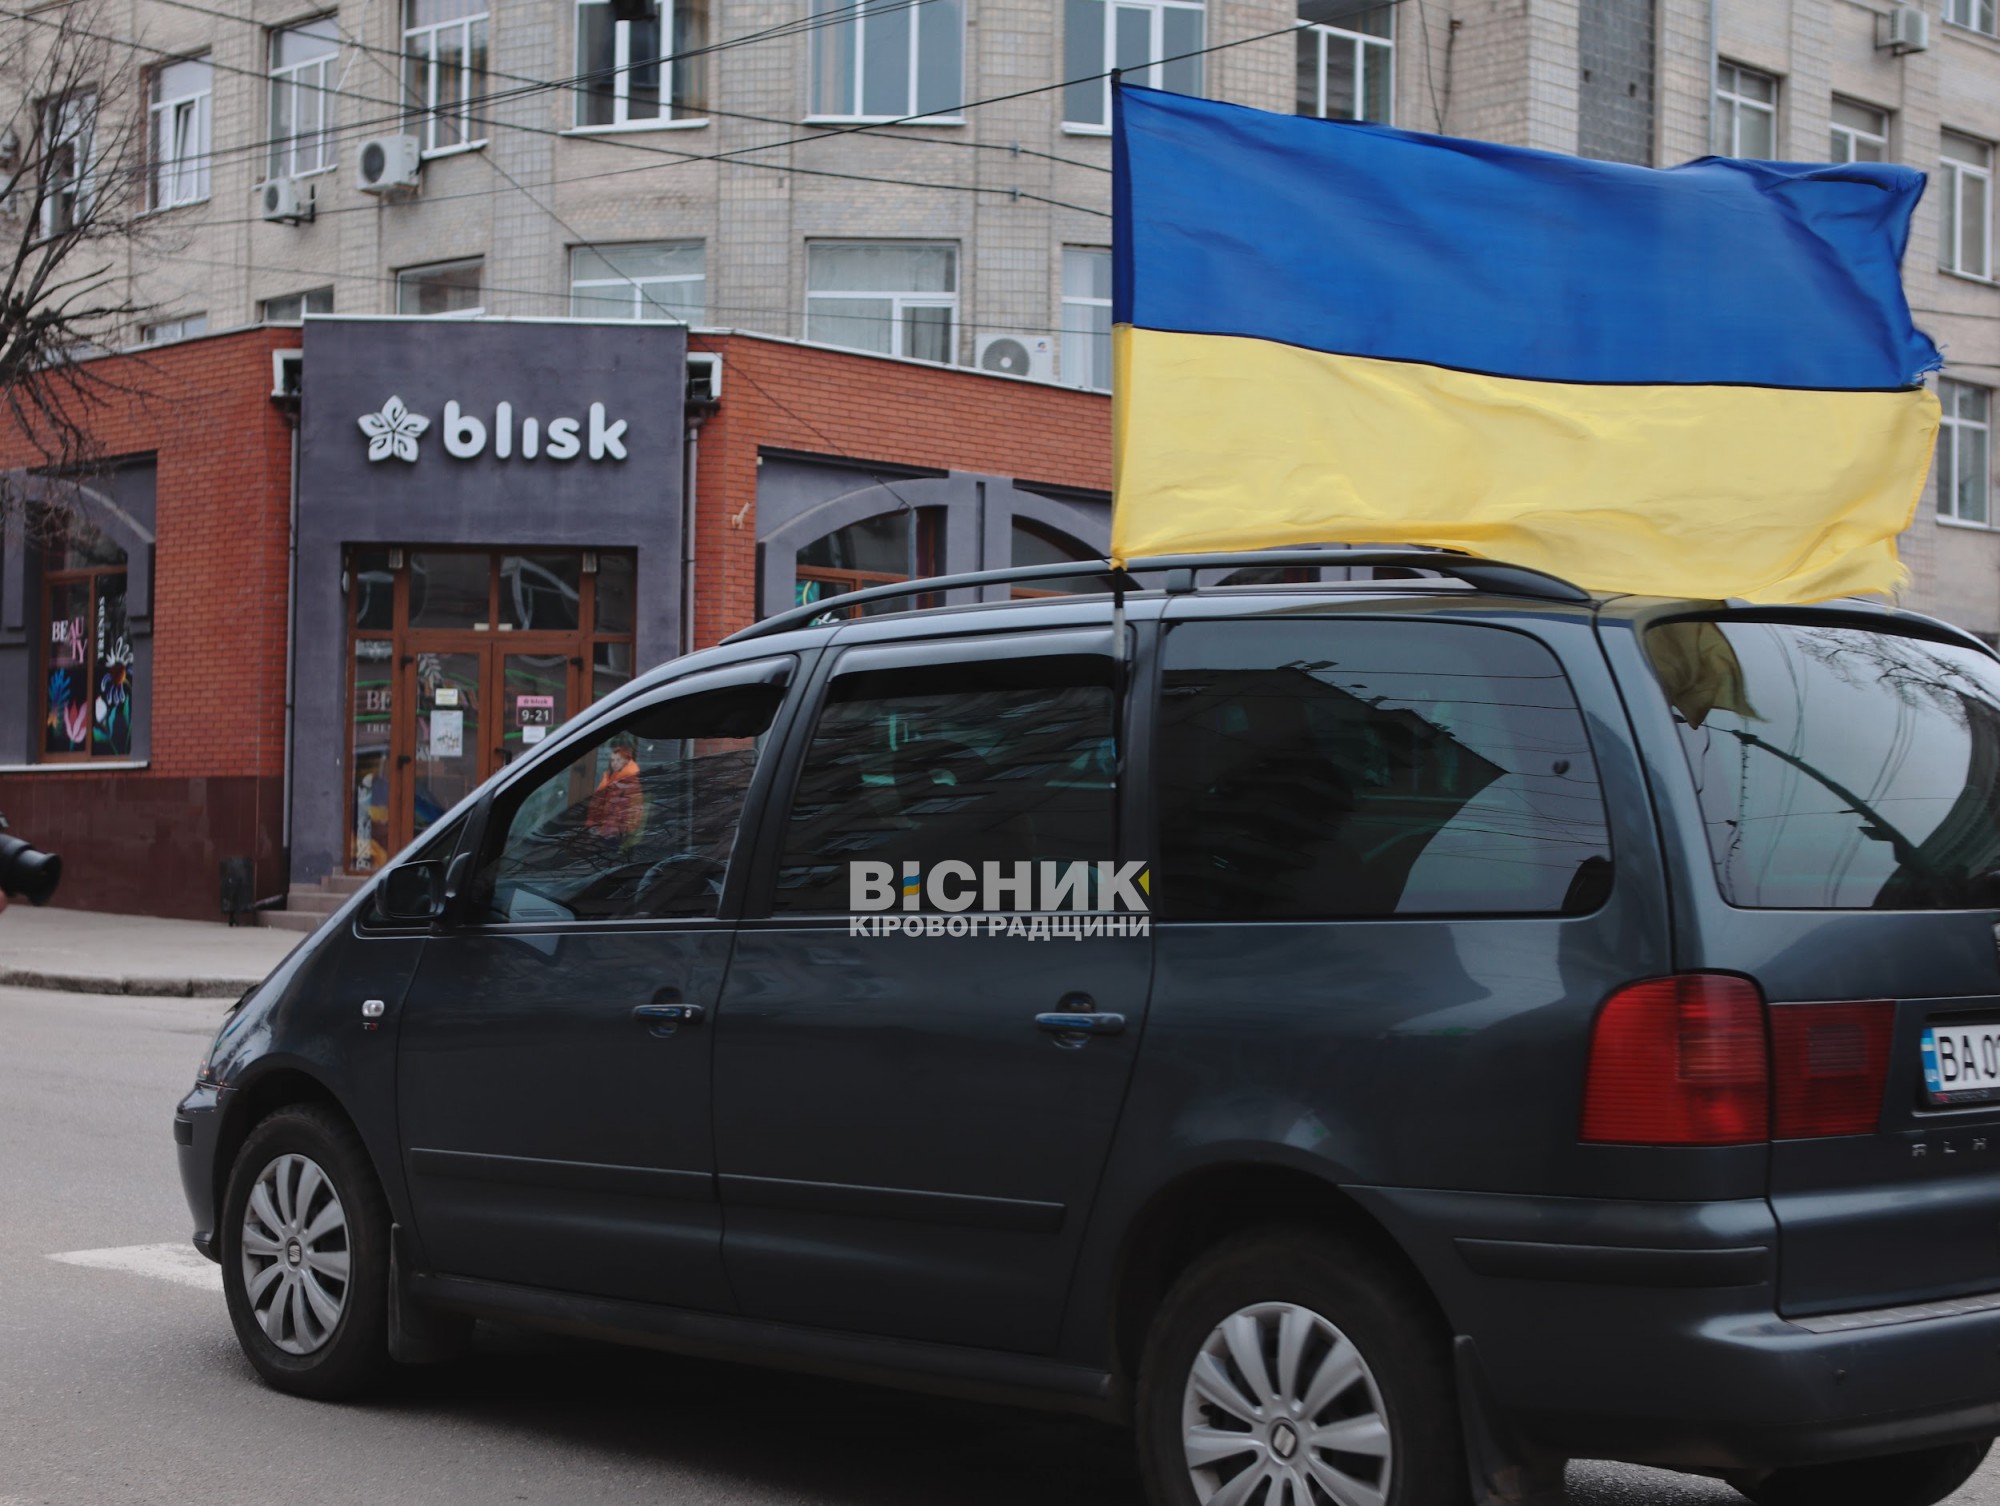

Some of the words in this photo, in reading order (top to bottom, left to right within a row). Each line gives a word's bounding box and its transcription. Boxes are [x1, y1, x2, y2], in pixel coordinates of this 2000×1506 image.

[443, 400, 629, 461] blisk
[52, 616, 84, 645] BEAU
[522, 709, 549, 722] 9-21
[1938, 1033, 2000, 1082] BA0
